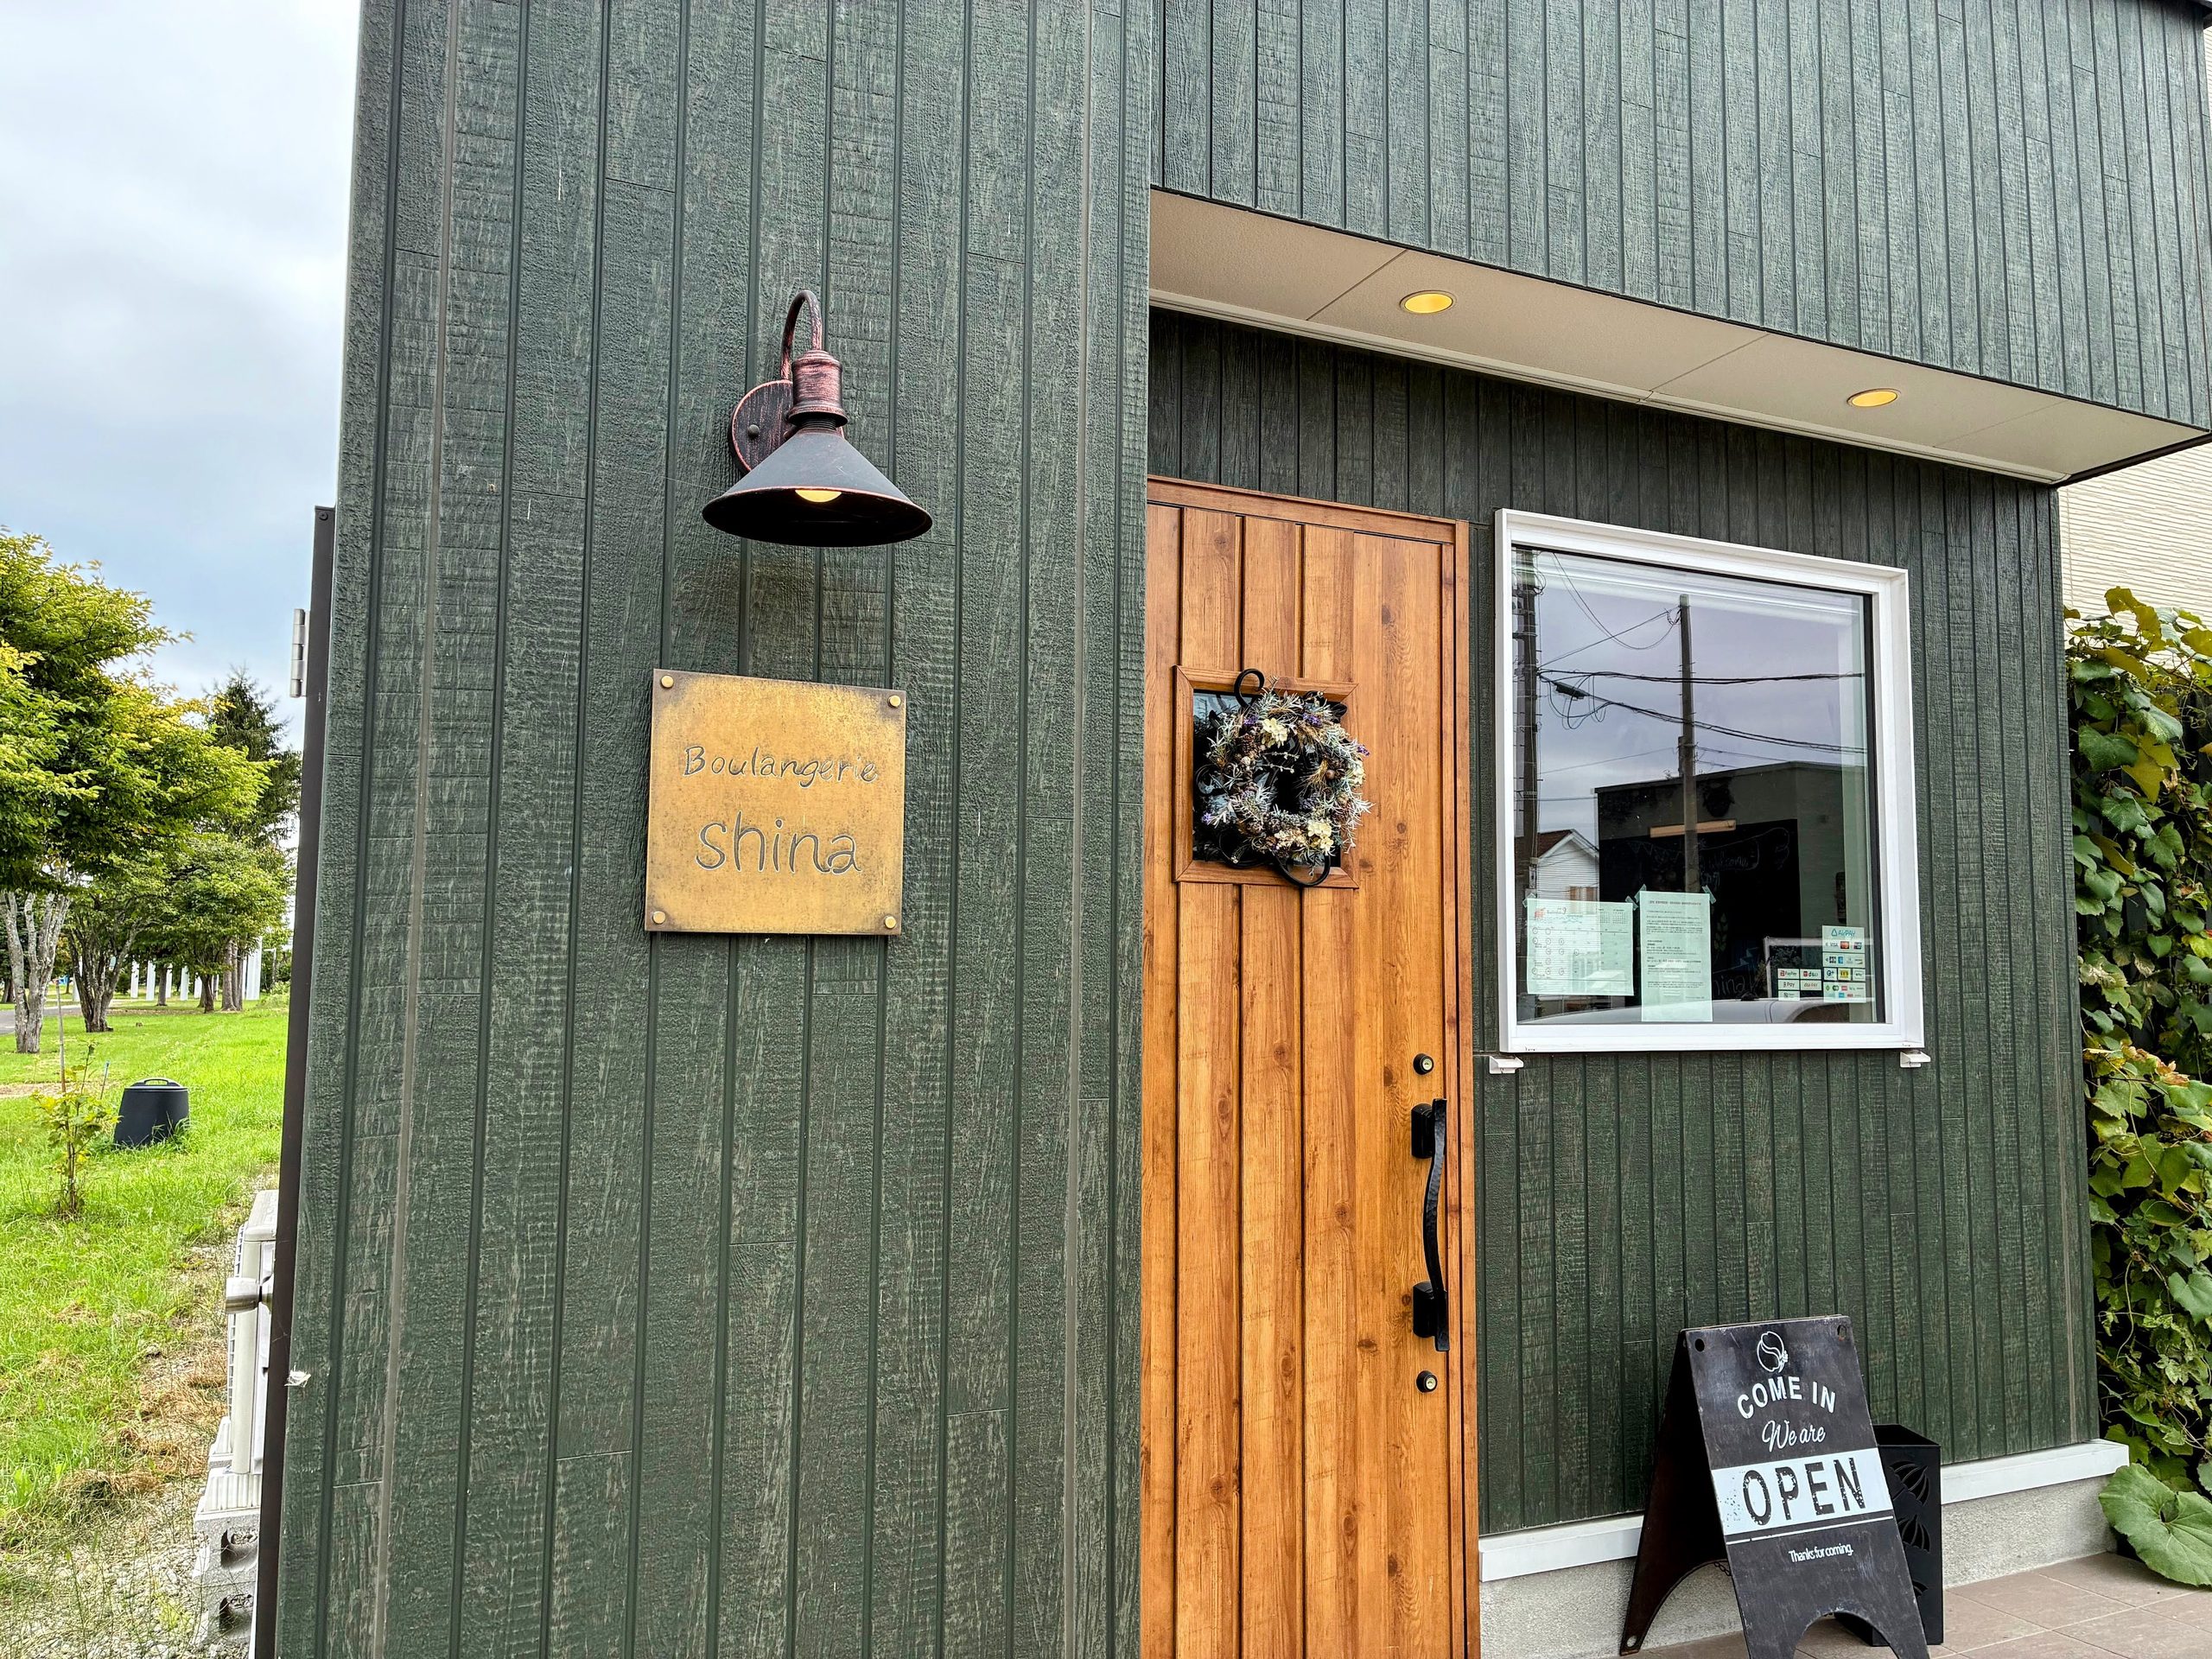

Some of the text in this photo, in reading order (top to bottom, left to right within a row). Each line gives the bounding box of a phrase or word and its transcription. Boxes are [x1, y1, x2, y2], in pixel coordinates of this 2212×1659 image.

[684, 745, 878, 788] Boulangerie
[1737, 1376, 1836, 1420] COME IN
[1761, 1420, 1827, 1452] We are
[1742, 1457, 1866, 1527] OPEN
[1788, 1542, 1854, 1563] Thanks for coming.
